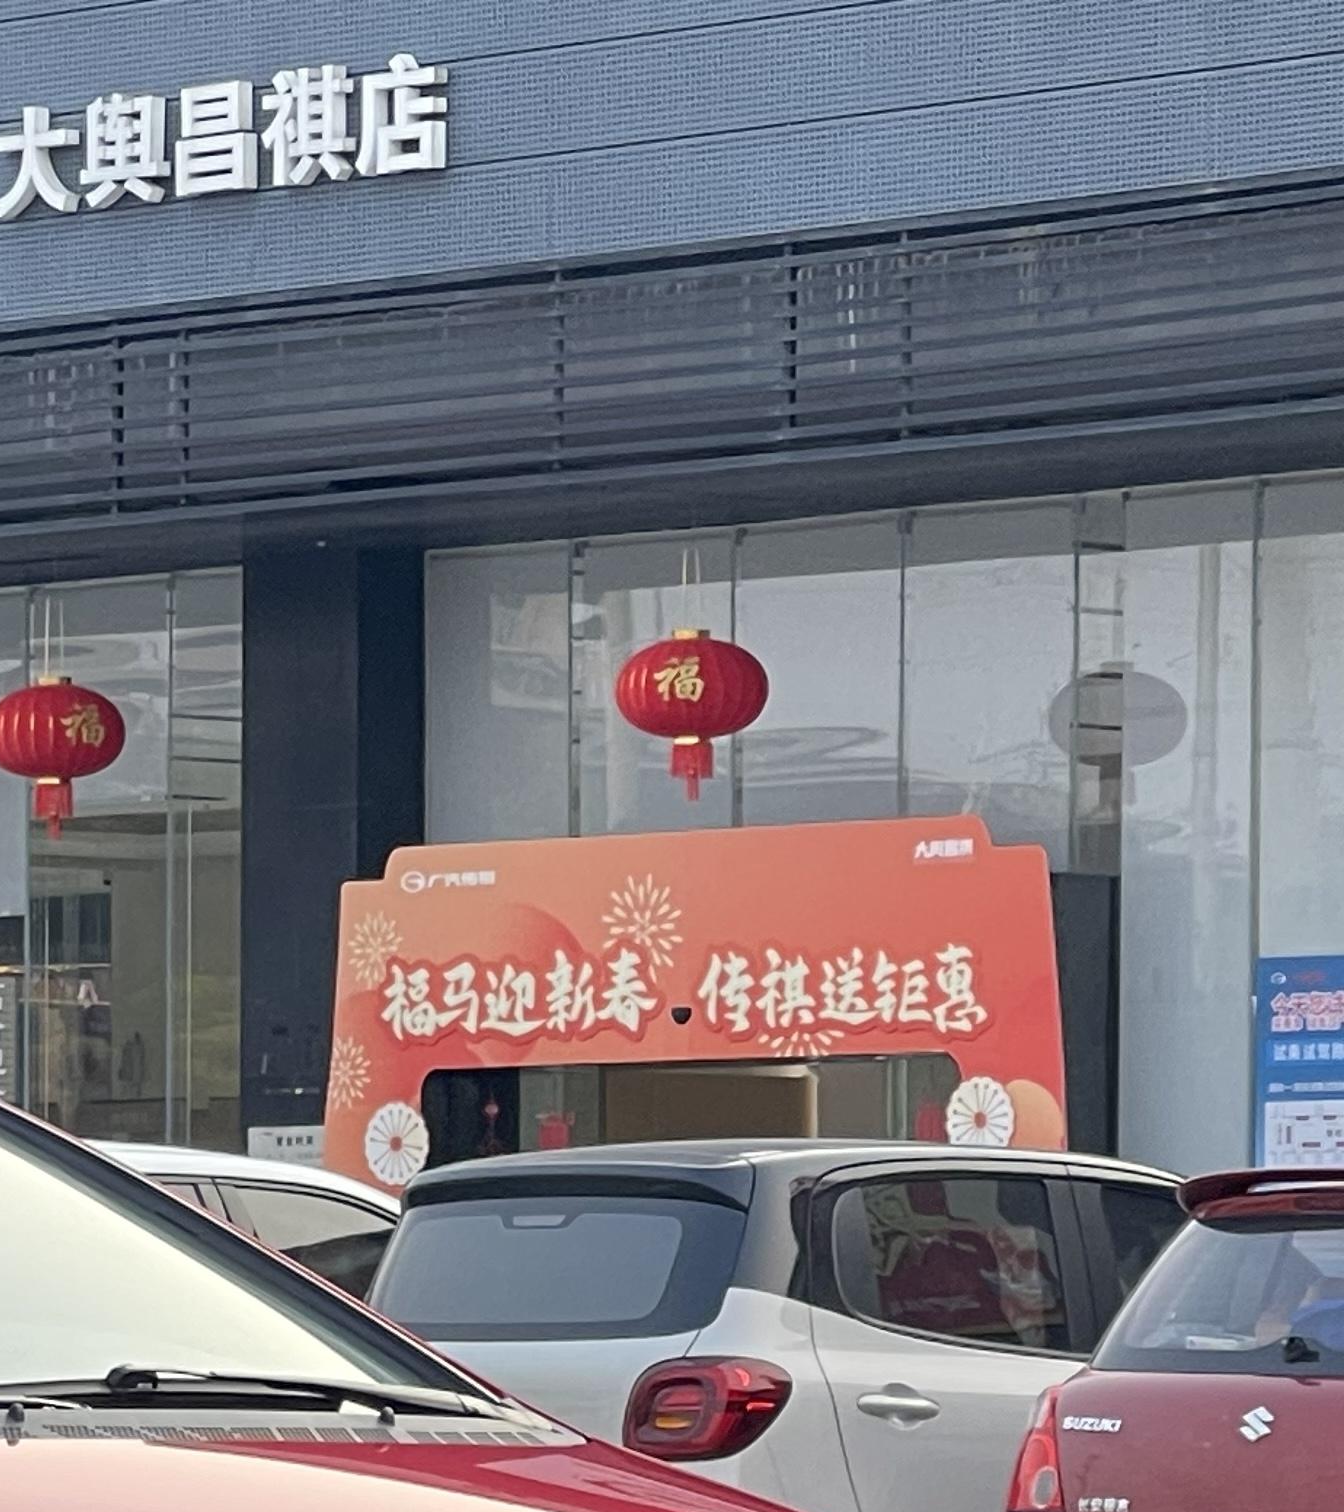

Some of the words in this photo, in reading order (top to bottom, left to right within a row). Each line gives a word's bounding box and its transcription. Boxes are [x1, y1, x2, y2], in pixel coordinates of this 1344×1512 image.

[653, 656, 705, 703] 福
[59, 703, 106, 748] 福
[380, 946, 660, 1042] 福马迎新春
[1062, 1416, 1122, 1432] SUZUKI
